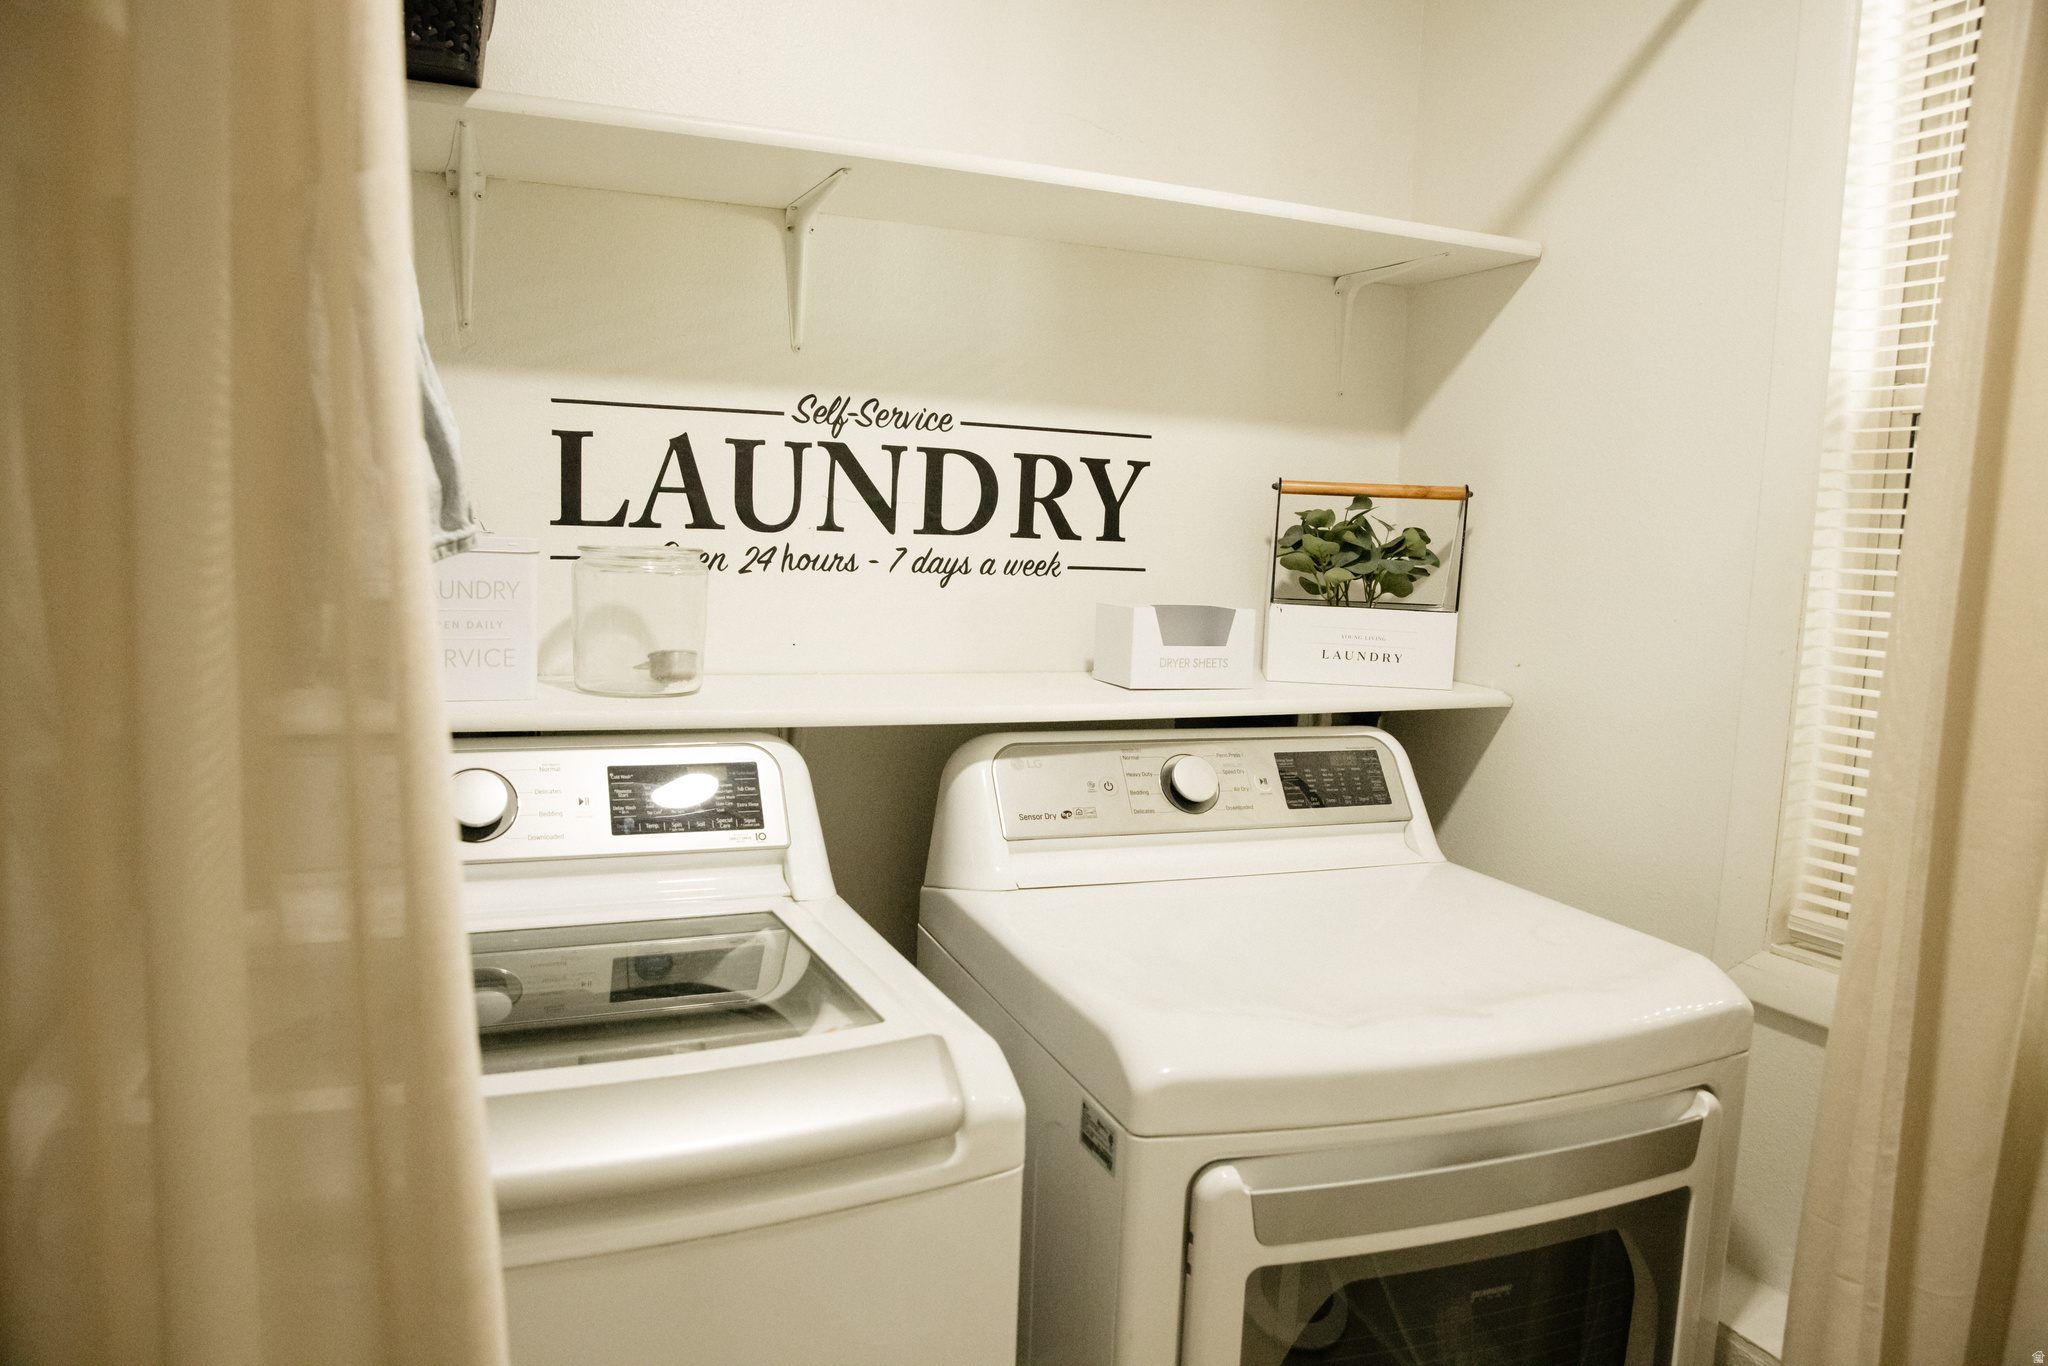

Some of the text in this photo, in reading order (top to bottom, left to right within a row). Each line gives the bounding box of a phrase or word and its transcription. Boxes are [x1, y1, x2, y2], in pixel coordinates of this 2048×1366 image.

[790, 393, 954, 439] Self-Service
[550, 429, 1151, 542] LAUNDRY
[738, 546, 778, 574] 24
[781, 542, 859, 573] hours
[889, 547, 907, 573] 7
[911, 547, 972, 589] days
[980, 561, 997, 576] a
[1003, 551, 1061, 577] week
[433, 580, 521, 600] UNDRY
[466, 620, 504, 630] DAILY
[444, 648, 516, 668] RVICE
[1159, 657, 1229, 669] DRYER SHEETS
[1321, 649, 1403, 664] LAUNDRY
[1018, 812, 1057, 821] Sensor Dry
[527, 833, 565, 841] Downloaded
[755, 832, 767, 841] 10
